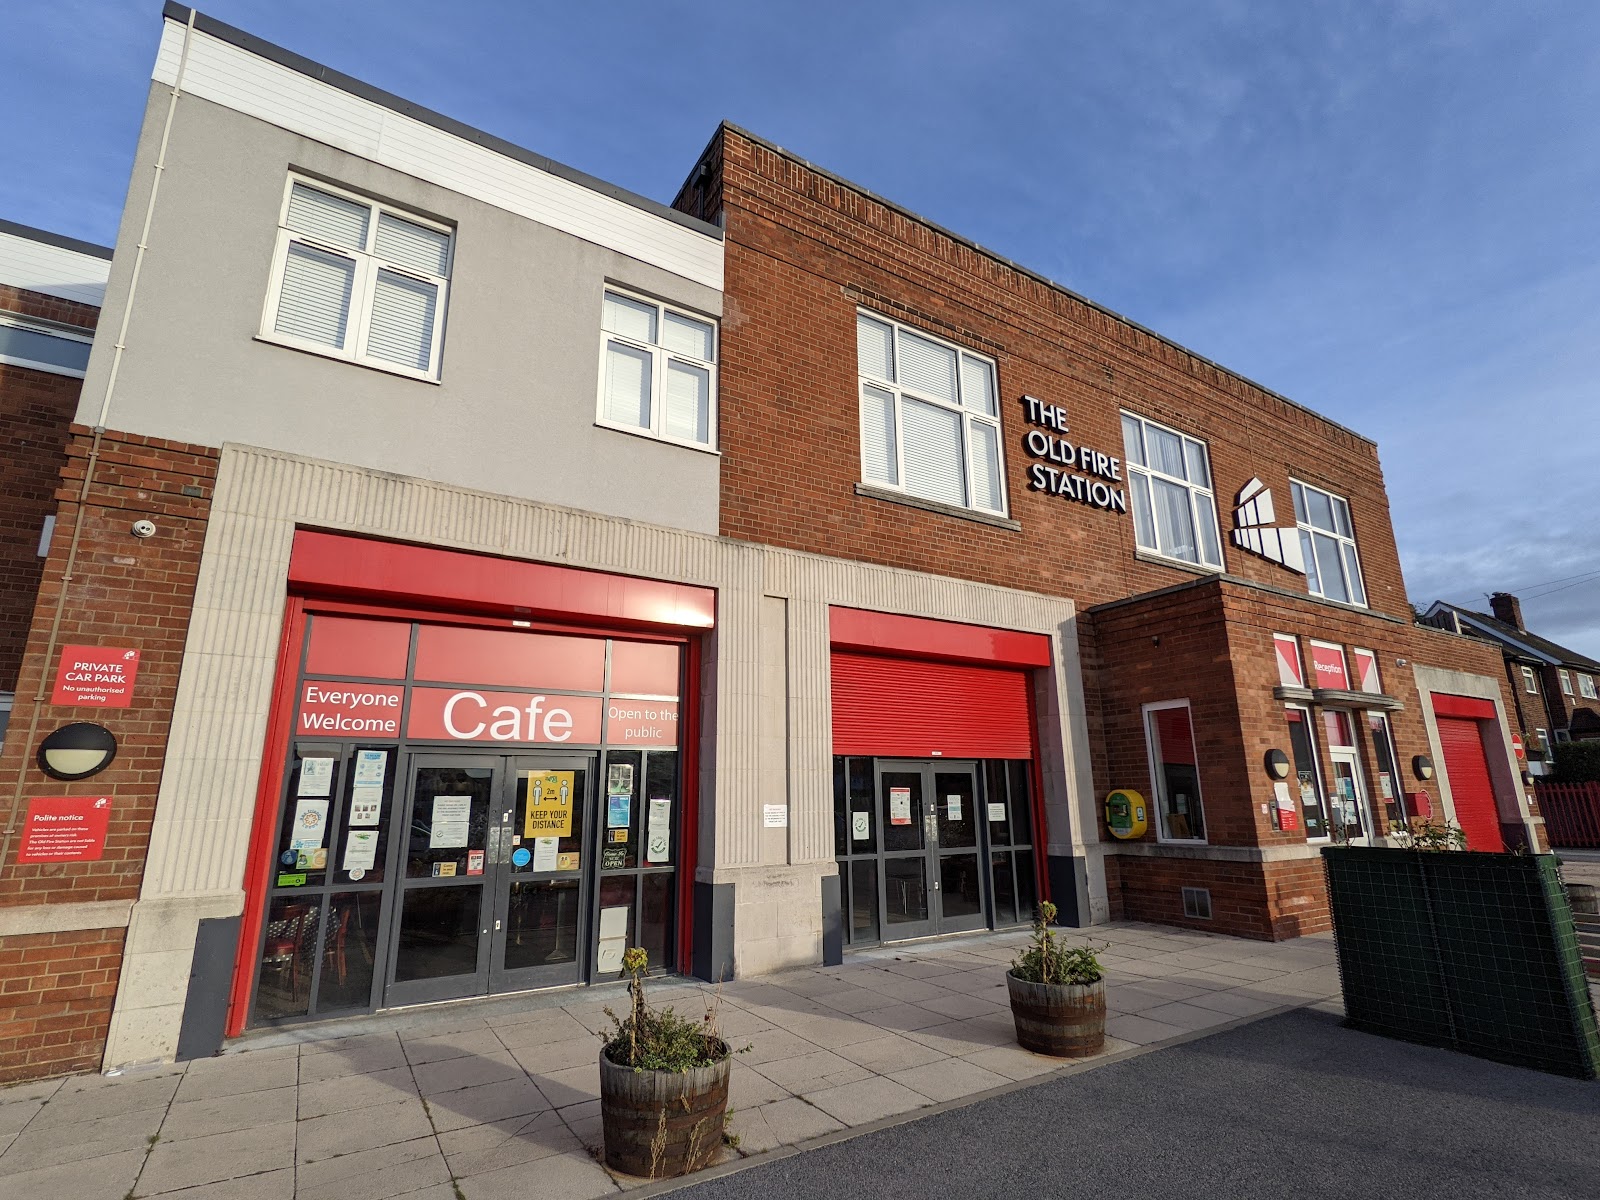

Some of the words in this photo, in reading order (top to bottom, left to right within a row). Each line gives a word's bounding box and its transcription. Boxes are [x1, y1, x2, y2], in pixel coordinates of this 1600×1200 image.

[1024, 395, 1069, 432] THE
[1028, 430, 1076, 465] OLD
[1080, 446, 1122, 481] FIRE
[1032, 463, 1126, 513] STATION
[73, 662, 123, 673] PRIVATE
[1313, 660, 1342, 675] Reception
[65, 672, 93, 682] CAR
[94, 674, 126, 684] PARK
[62, 684, 75, 692] No
[76, 686, 125, 694] unauthorised
[78, 694, 106, 702] parking
[305, 686, 399, 708] Everyone
[442, 691, 574, 742] Cafe
[608, 706, 642, 722] Open
[644, 709, 658, 721] to
[660, 708, 680, 722] the
[302, 712, 396, 733] Welcome
[624, 726, 663, 740] public
[546, 787, 556, 795] 2m
[33, 814, 58, 822] Polite
[530, 810, 548, 820] KEEP
[550, 810, 568, 819] YOUR
[532, 819, 565, 829] DISTANCE
